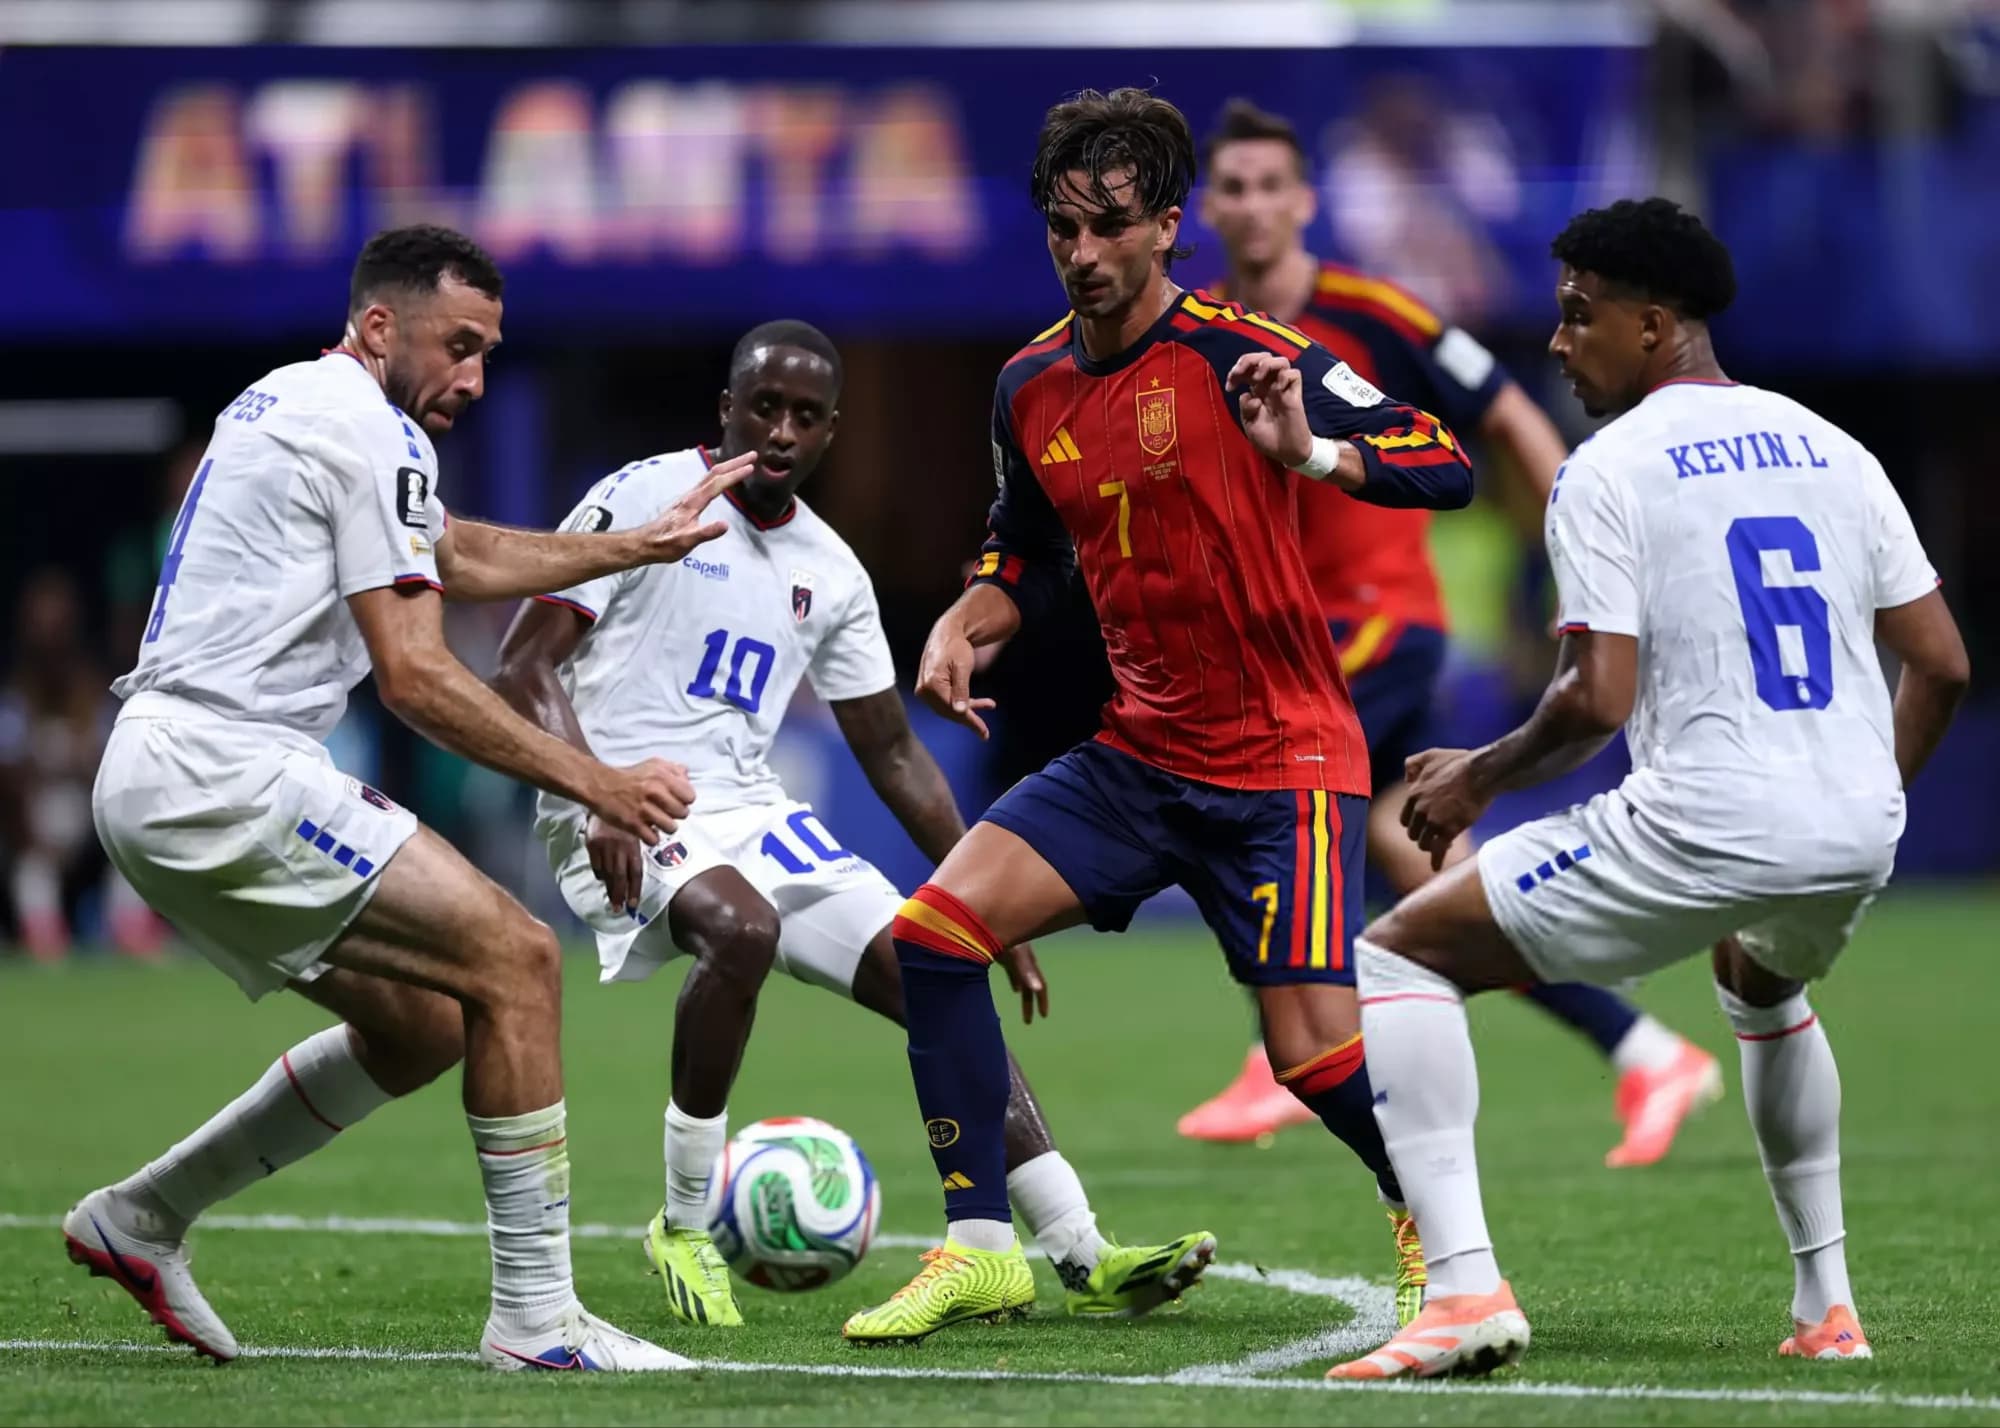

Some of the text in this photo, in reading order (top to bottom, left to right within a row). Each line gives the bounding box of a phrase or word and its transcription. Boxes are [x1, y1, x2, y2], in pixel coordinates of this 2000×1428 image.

[124, 82, 982, 262] ATLANTA
[1665, 431, 1828, 479] KEVIN.L
[145, 458, 214, 643] 4
[1098, 480, 1132, 558] 7
[683, 556, 730, 578] capelli
[1725, 516, 1833, 711] 6
[686, 628, 776, 714] 10
[760, 810, 853, 875] 10
[1252, 882, 1279, 963] 7
